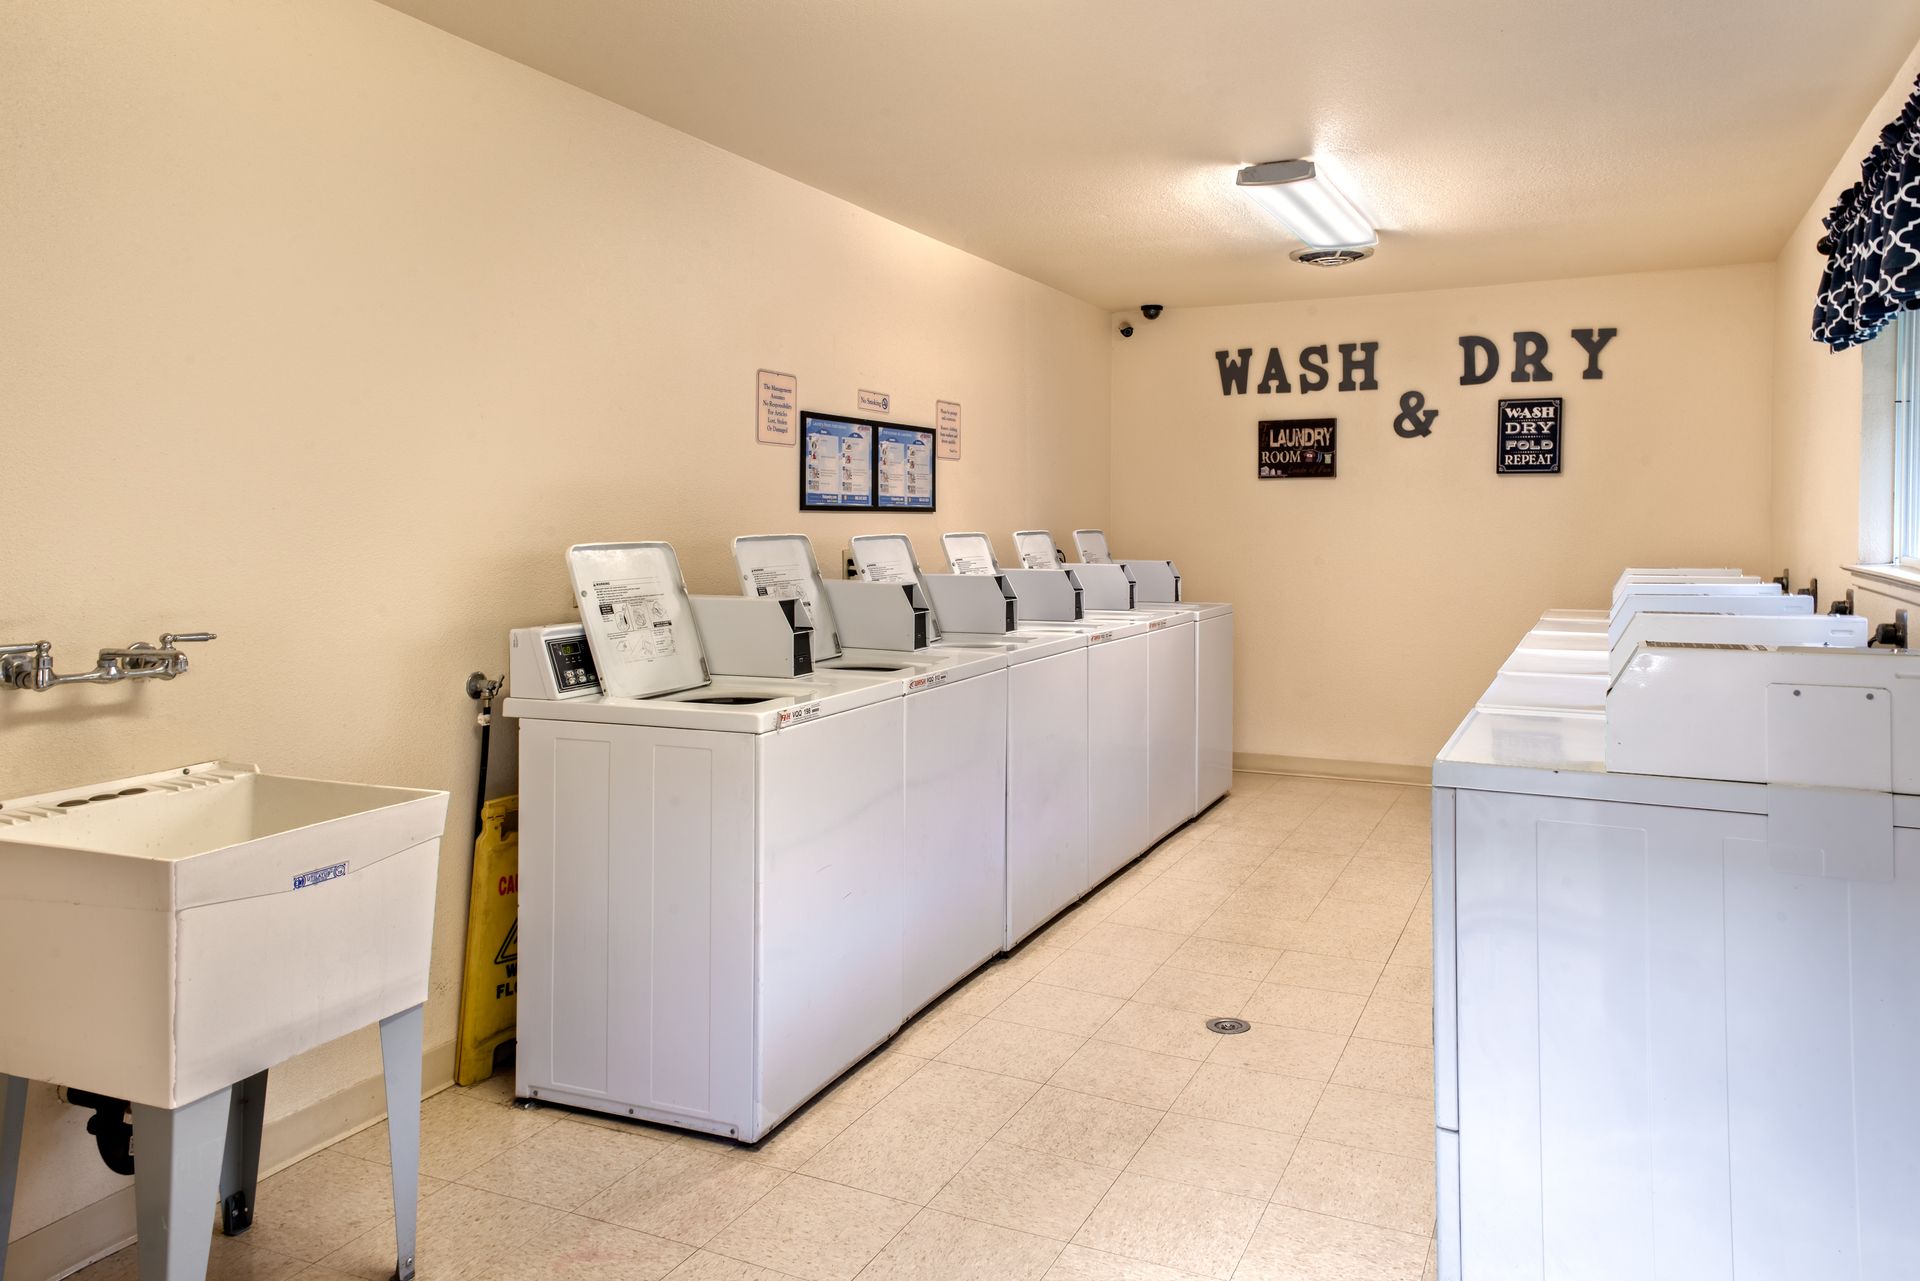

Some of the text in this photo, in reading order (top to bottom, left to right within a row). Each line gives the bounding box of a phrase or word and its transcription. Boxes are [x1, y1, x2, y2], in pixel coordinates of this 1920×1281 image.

[771, 384, 792, 393] Management
[1215, 328, 1617, 438] WASH & DRY
[762, 399, 792, 409] No Responsibility
[866, 397, 882, 408] Smoking
[1504, 406, 1556, 419] WASH
[1504, 421, 1556, 434] DRY
[1269, 427, 1333, 448] LAUNDRY
[1505, 439, 1554, 450] FOLD
[1261, 450, 1301, 464] ROOM
[1504, 453, 1554, 466] REPEAT
